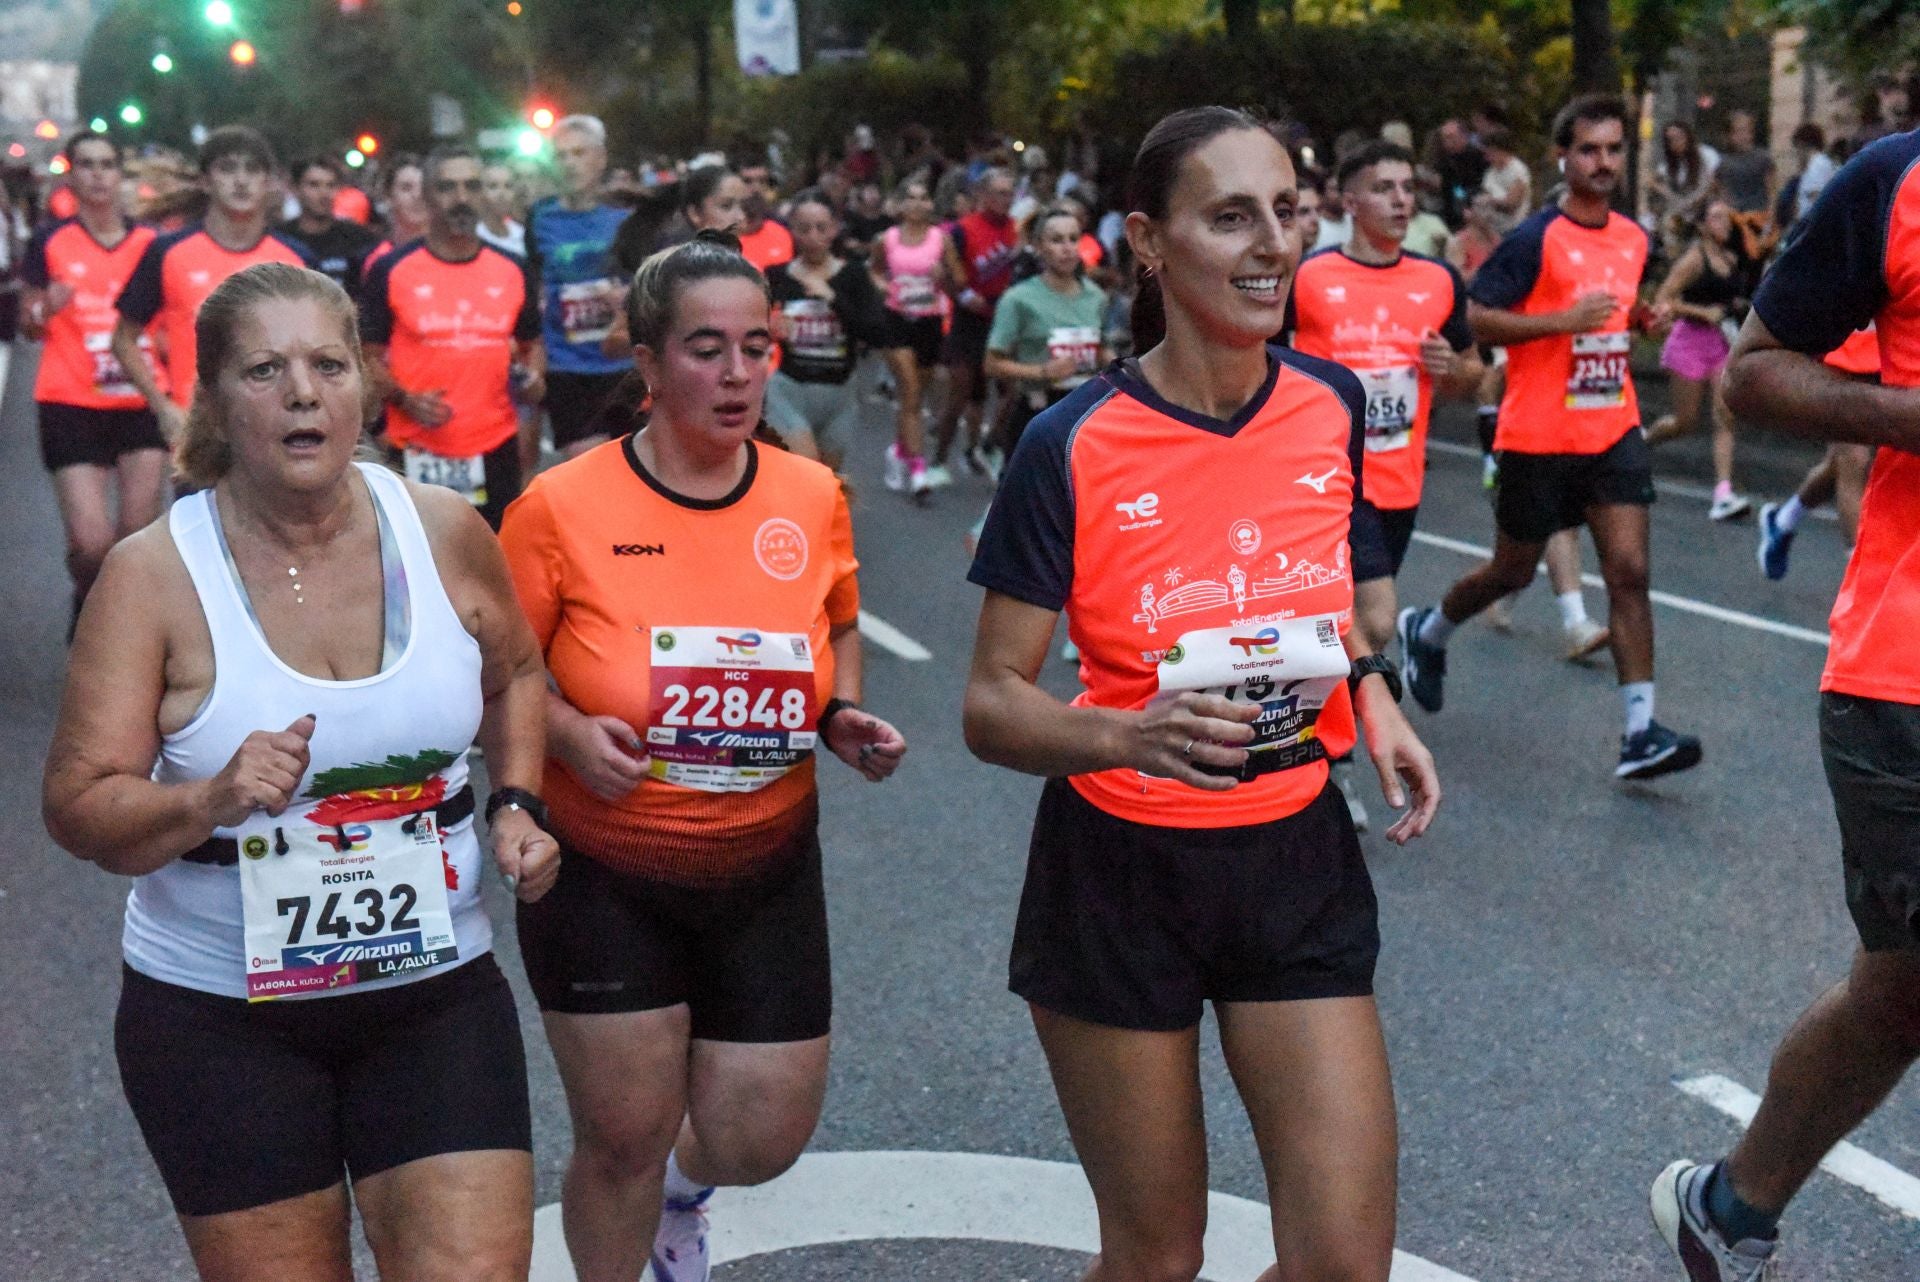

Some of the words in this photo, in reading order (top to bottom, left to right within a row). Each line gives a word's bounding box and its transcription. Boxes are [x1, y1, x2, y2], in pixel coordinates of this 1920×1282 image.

[1367, 396, 1407, 418] 656
[1230, 609, 1295, 628] TotalEnergies
[1232, 658, 1284, 670] TotalEnergies
[724, 671, 749, 681] HCC
[662, 684, 806, 729] 22848
[1262, 723, 1276, 735] LA
[1278, 712, 1303, 732] SALVE
[750, 751, 763, 760] LA
[763, 751, 797, 760] SALVE
[319, 854, 375, 868] TotalEnergies
[321, 870, 375, 885] ROSITA
[276, 883, 420, 945] 7432
[378, 960, 396, 973] LA
[396, 953, 439, 970] SALVE
[253, 979, 297, 991] LABORAL
[299, 977, 325, 985] kutxa
